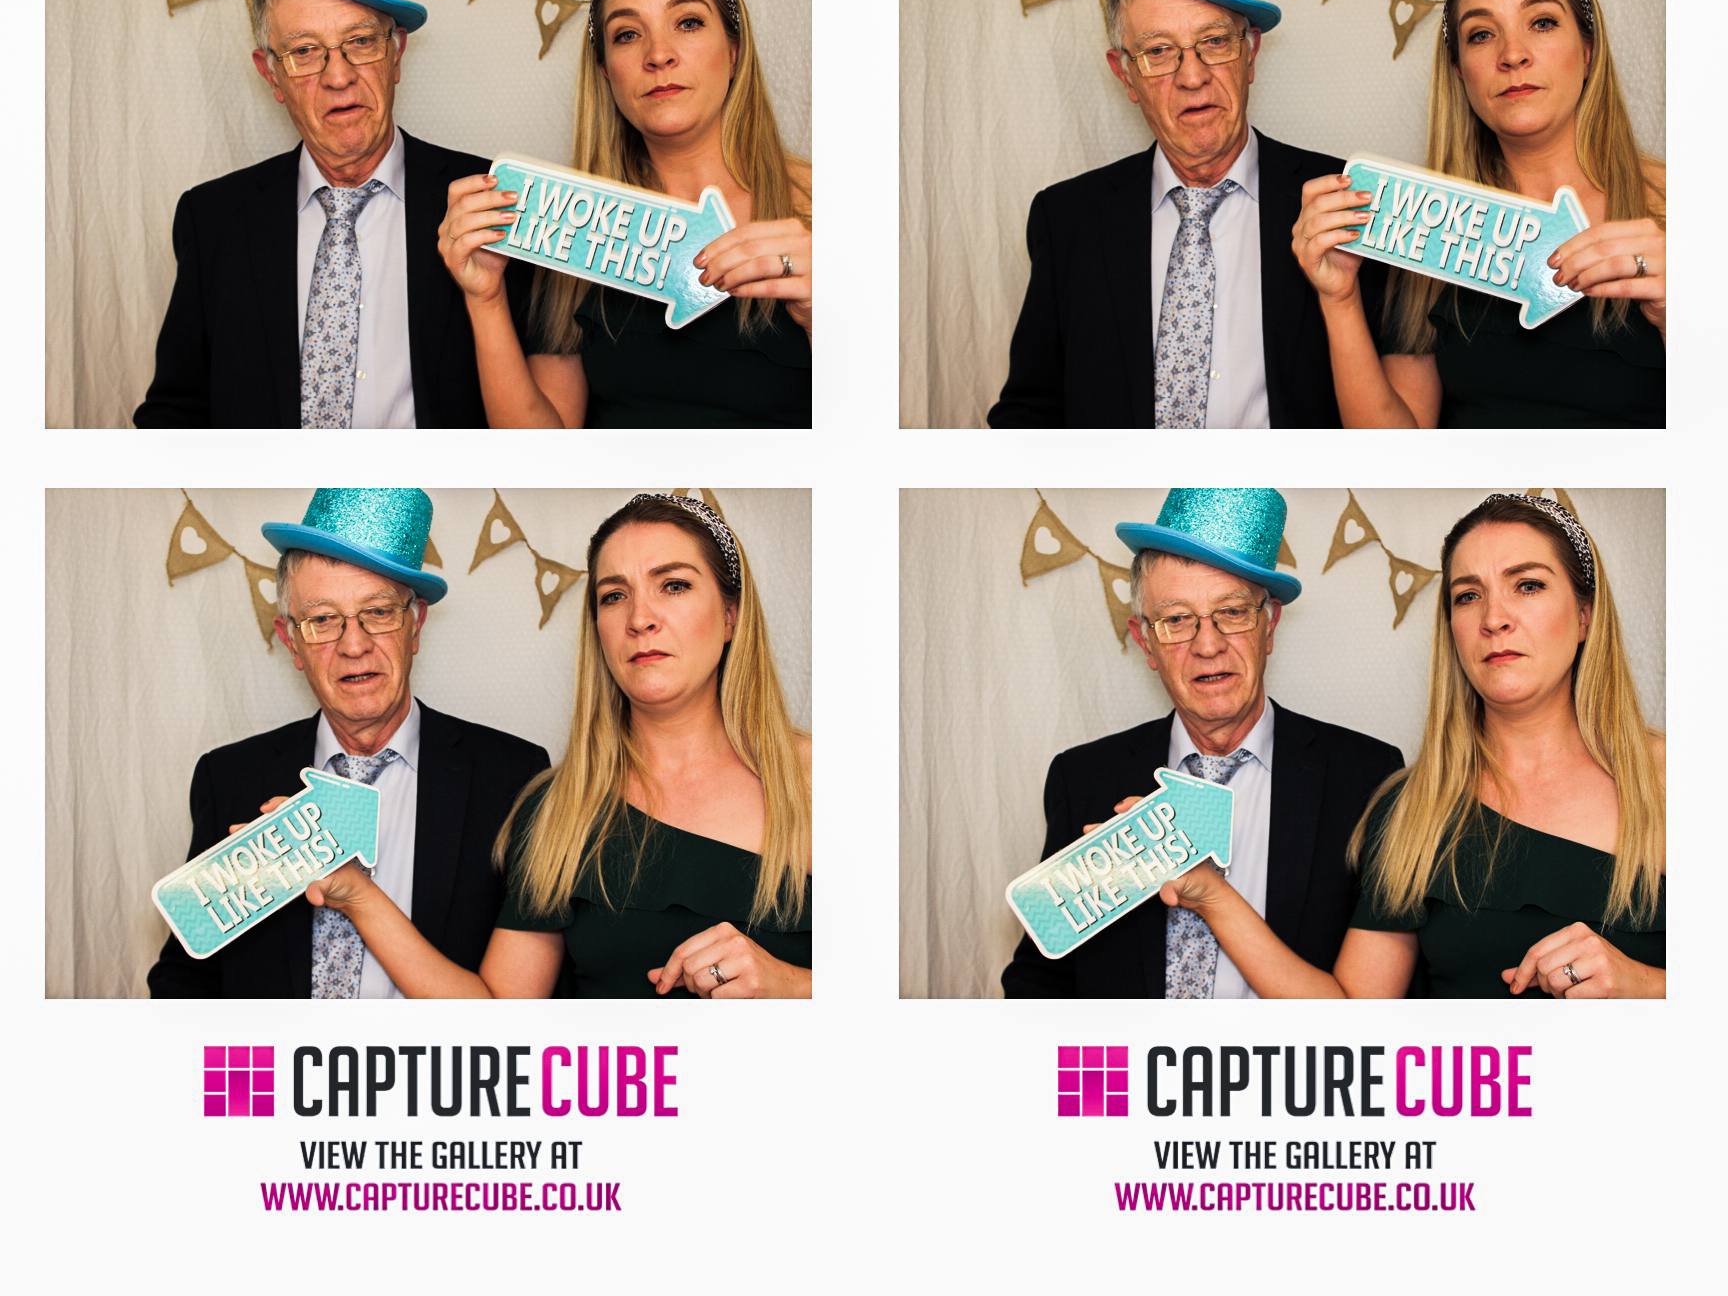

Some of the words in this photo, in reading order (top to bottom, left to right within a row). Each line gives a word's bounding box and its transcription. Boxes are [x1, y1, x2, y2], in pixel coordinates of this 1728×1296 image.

[507, 212, 576, 262] LIKE
[585, 231, 672, 290] THIS!
[516, 176, 534, 212] I
[538, 180, 635, 240] WOKE
[638, 207, 687, 252] UP
[1361, 212, 1430, 262] LIKE
[1439, 231, 1526, 290] THIS!
[1370, 176, 1388, 212] I
[1392, 180, 1489, 240] WOKE
[1492, 207, 1541, 252] UP
[186, 876, 211, 907] I
[200, 825, 292, 894] WOKE
[282, 802, 322, 841] UP
[206, 876, 274, 933] LIKE
[266, 829, 344, 891] THIS!
[1040, 876, 1065, 907] I
[1054, 825, 1146, 894] WOKE
[1136, 802, 1176, 841] UP
[1060, 876, 1128, 933] LIKE
[1120, 829, 1198, 891] THIS!
